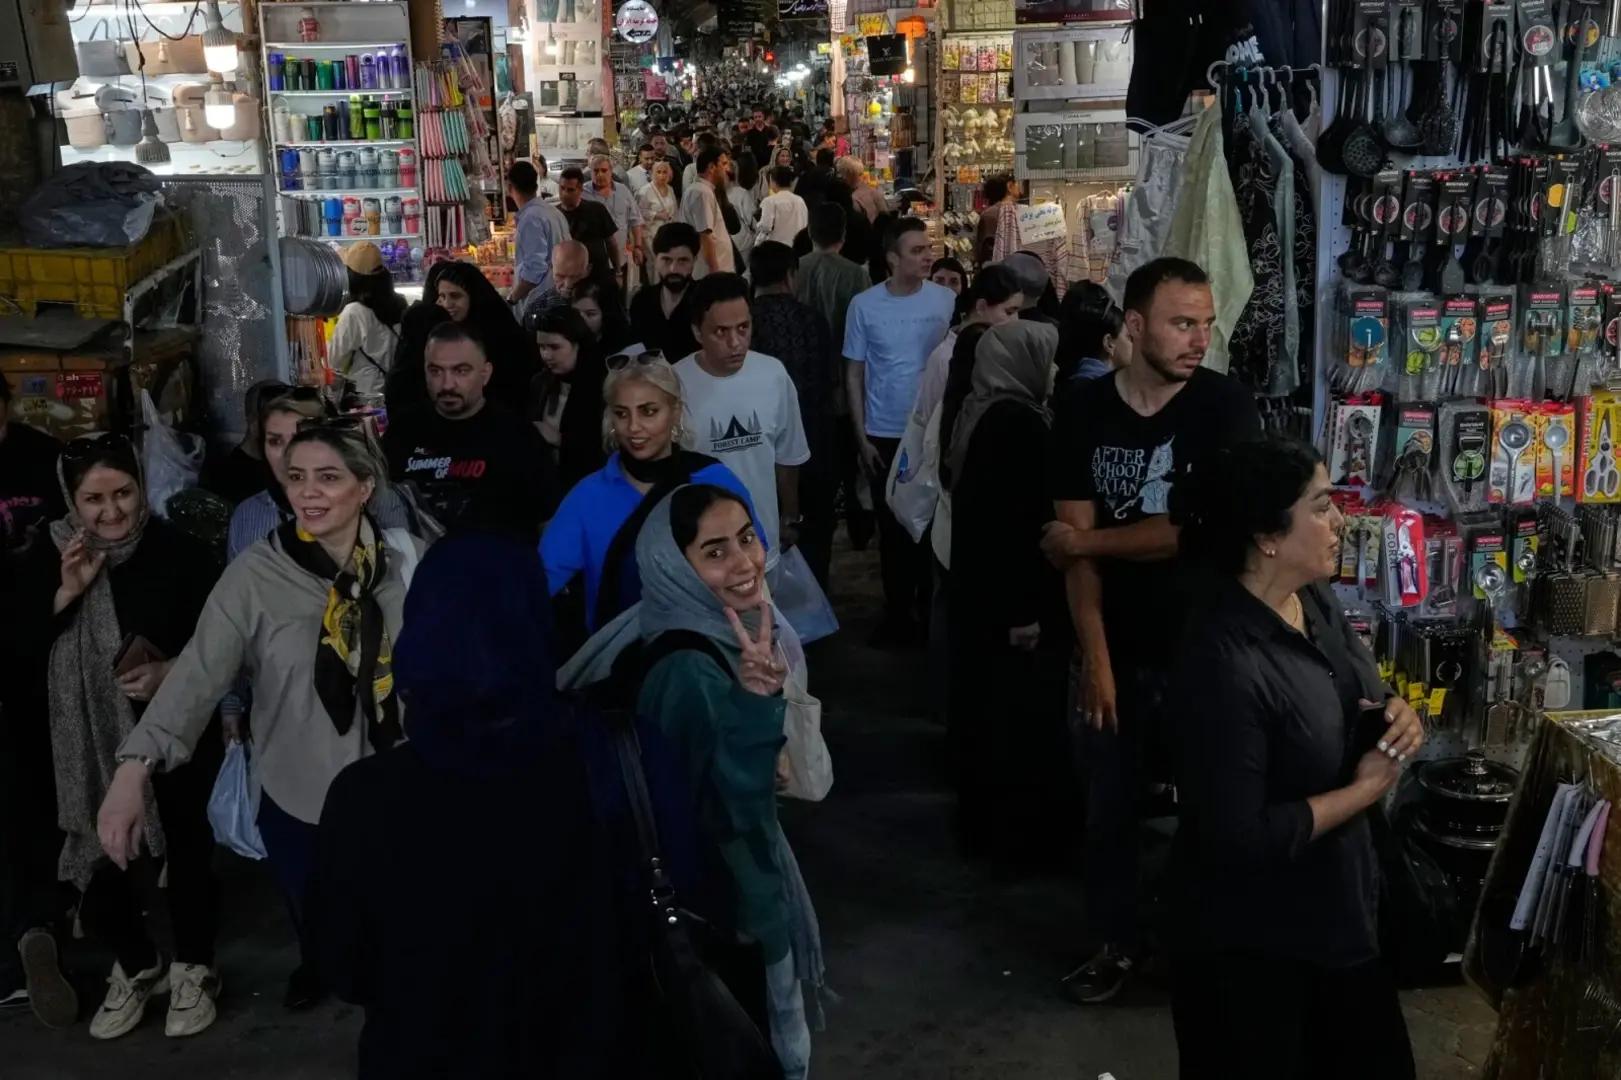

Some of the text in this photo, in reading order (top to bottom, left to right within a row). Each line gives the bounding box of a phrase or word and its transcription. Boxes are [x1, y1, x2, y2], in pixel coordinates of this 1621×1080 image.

[713, 435, 761, 449] FOREST CAMP
[405, 456, 452, 473] SUMMER
[1092, 445, 1146, 465] AFTER
[434, 468, 449, 479] OF
[1091, 461, 1145, 480] SCHOOL
[1094, 477, 1139, 497] SATAN
[1386, 532, 1398, 572] CORAL
